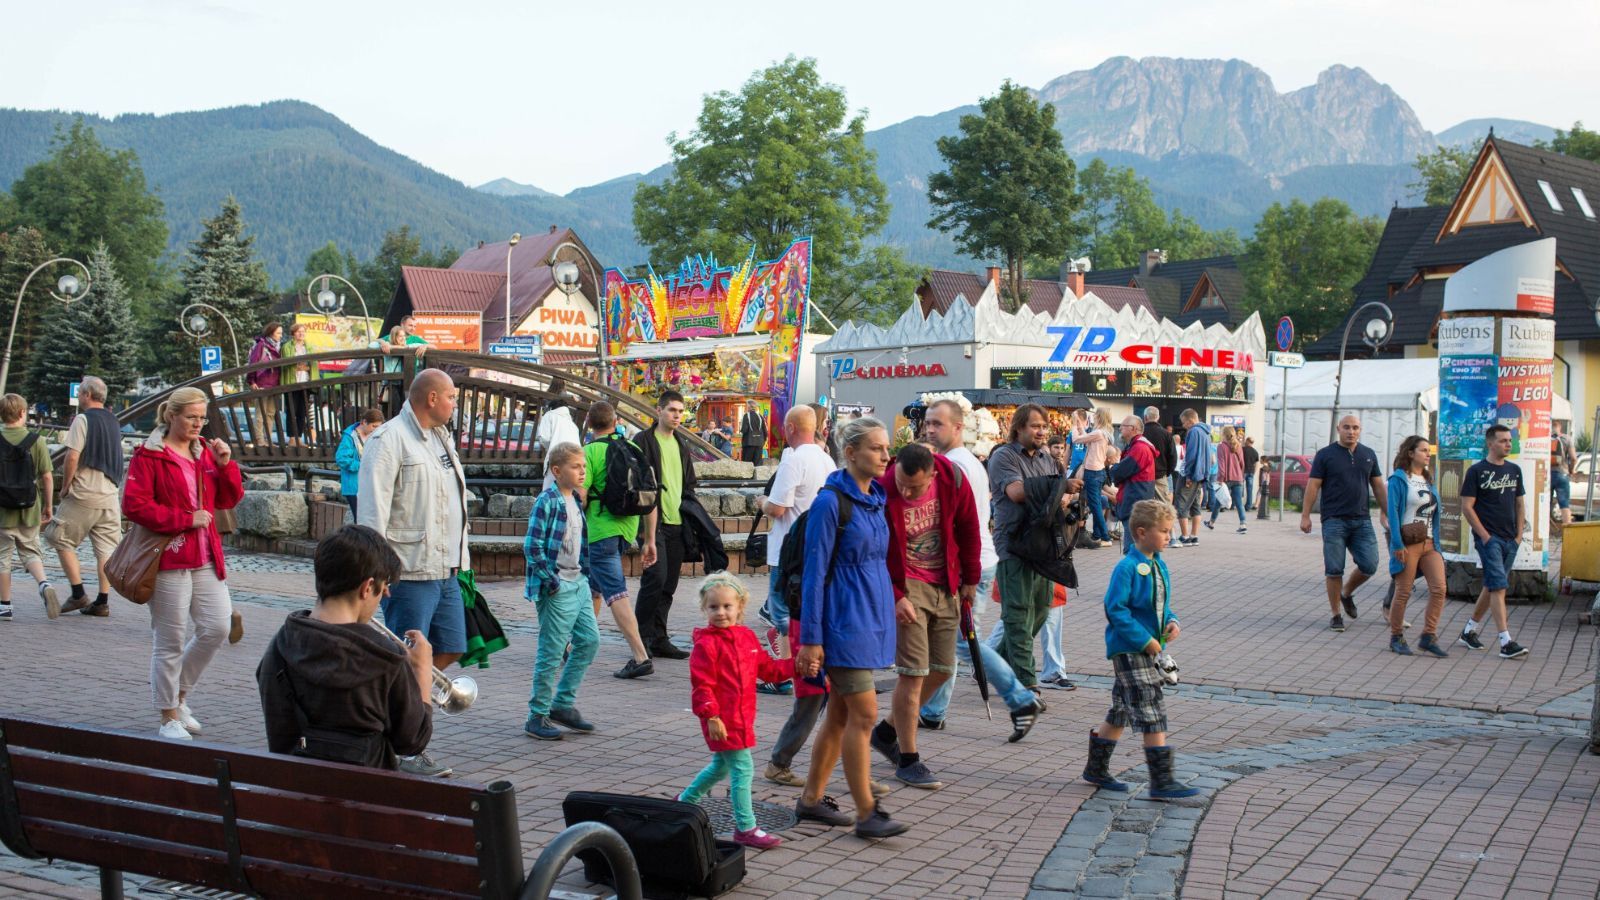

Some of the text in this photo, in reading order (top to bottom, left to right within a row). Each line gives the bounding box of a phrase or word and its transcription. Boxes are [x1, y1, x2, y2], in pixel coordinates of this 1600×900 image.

[540, 308, 587, 326] PIWA
[1046, 326, 1116, 362] 7D
[856, 363, 945, 378] CINEMA
[1512, 386, 1548, 402] LEGO
[1415, 489, 1438, 518] 2
